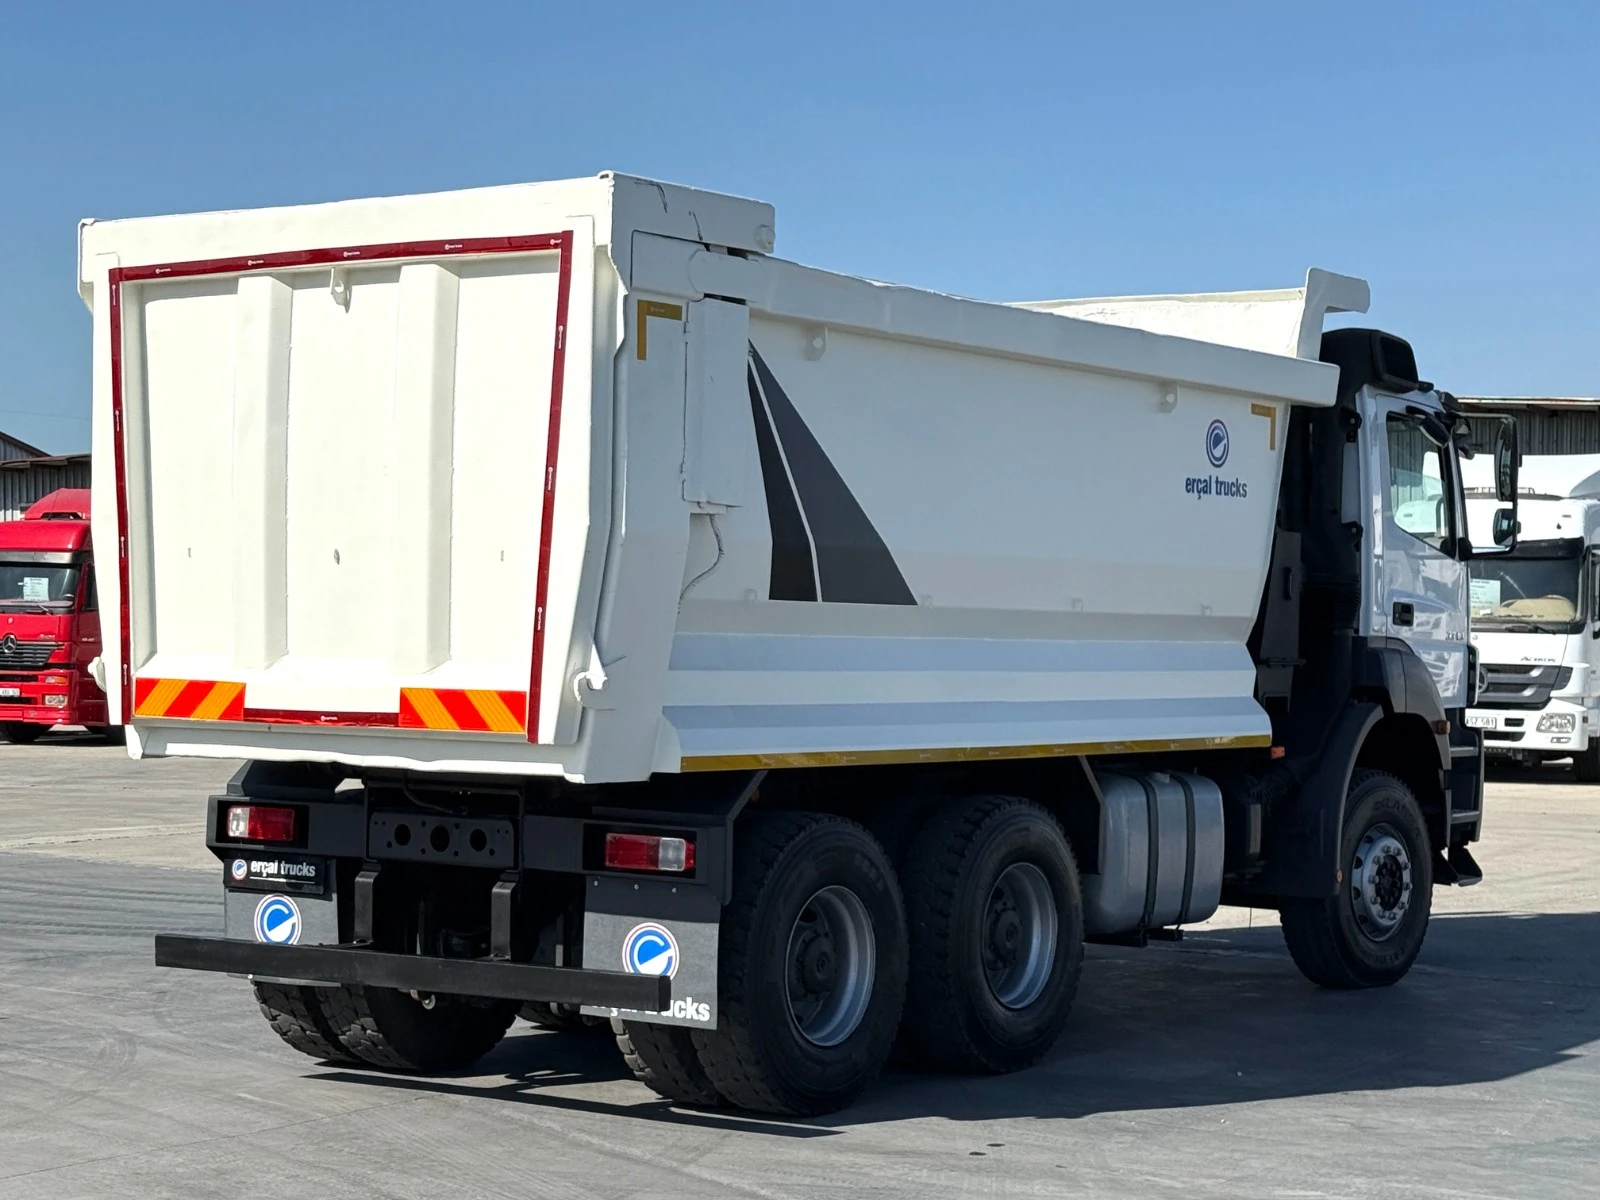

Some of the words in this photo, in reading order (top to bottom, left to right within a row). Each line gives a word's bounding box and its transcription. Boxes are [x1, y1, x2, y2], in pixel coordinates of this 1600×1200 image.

[1185, 475, 1212, 500] erçal
[1215, 475, 1248, 498] trucks
[250, 860, 279, 877] erçal
[280, 860, 316, 877] trucks
[645, 996, 710, 1022] ucks
